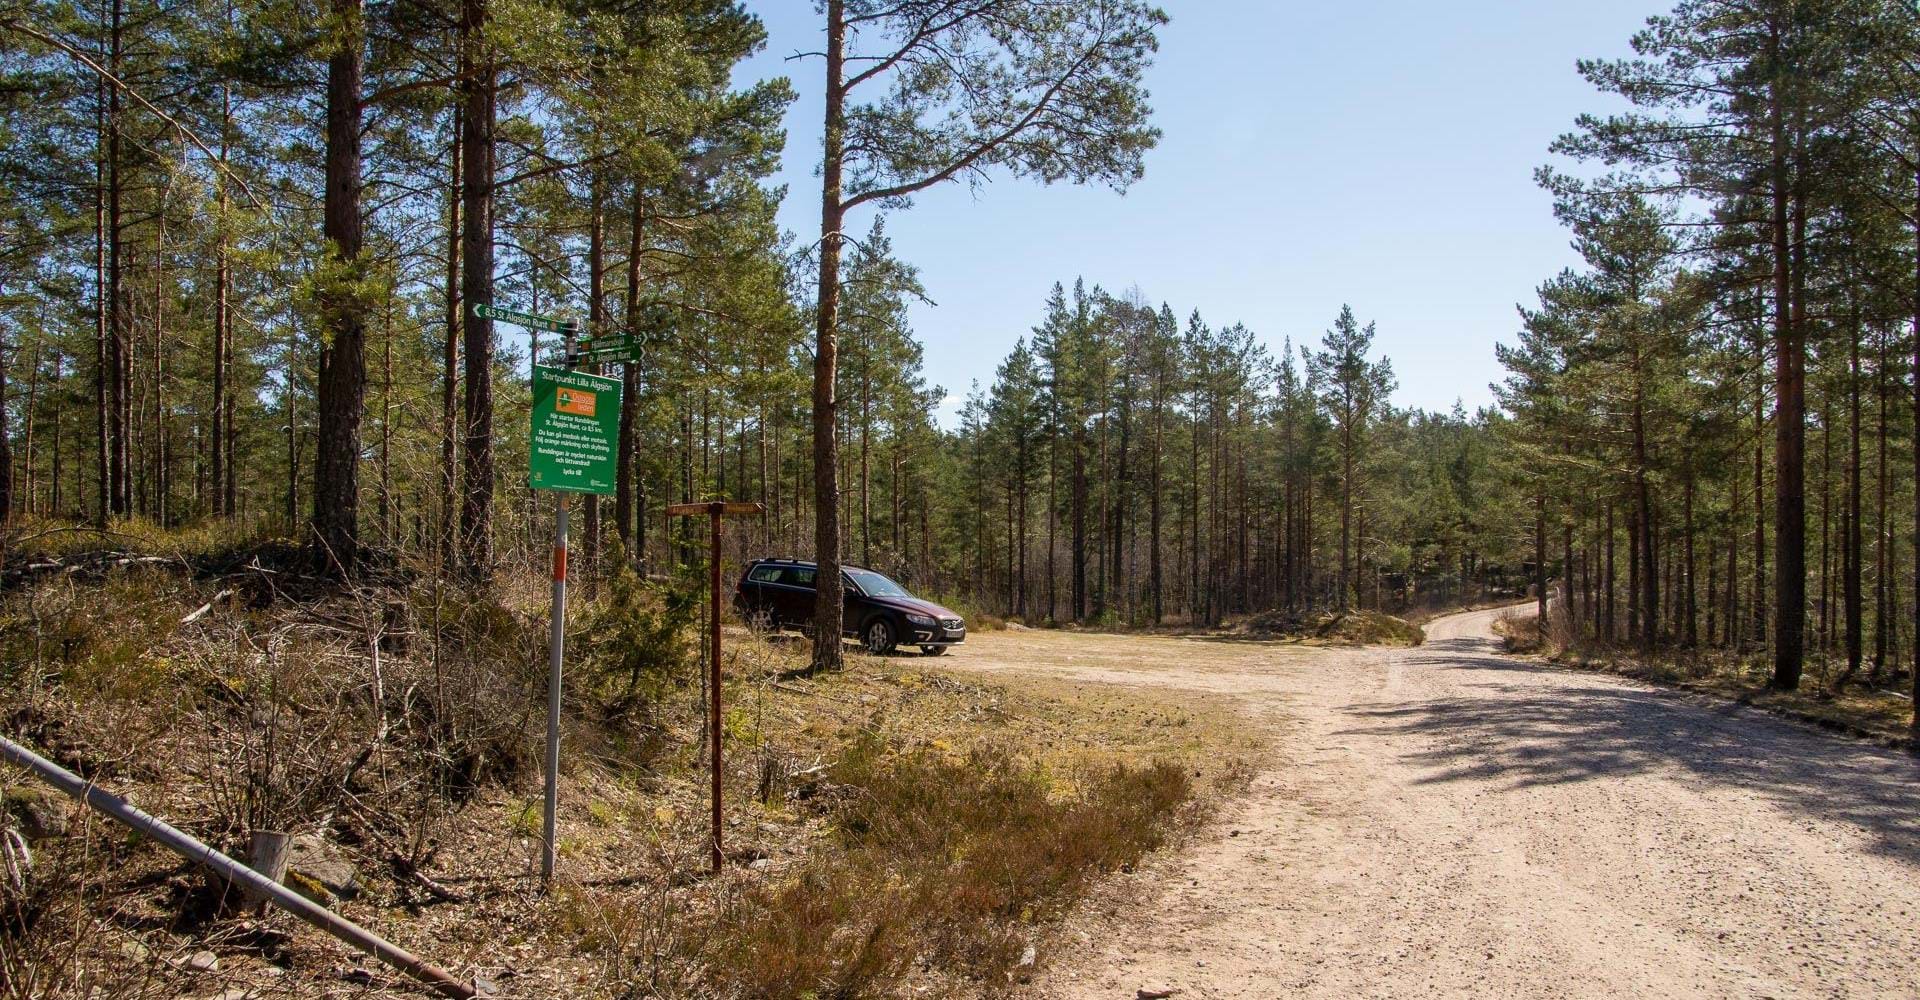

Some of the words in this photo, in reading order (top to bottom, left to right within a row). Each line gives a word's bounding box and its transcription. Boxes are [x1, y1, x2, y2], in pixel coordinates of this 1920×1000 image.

[533, 318, 548, 329] Runt
[617, 351, 631, 359] Runt
[542, 371, 576, 385] Startpunkt
[577, 378, 589, 387] Lilla
[590, 379, 613, 392] Älgsjön
[552, 420, 569, 429] Älgsjön
[556, 431, 562, 439] gå
[535, 435, 544, 444] Följ
[560, 440, 581, 449] märkning
[570, 451, 586, 460] mycket
